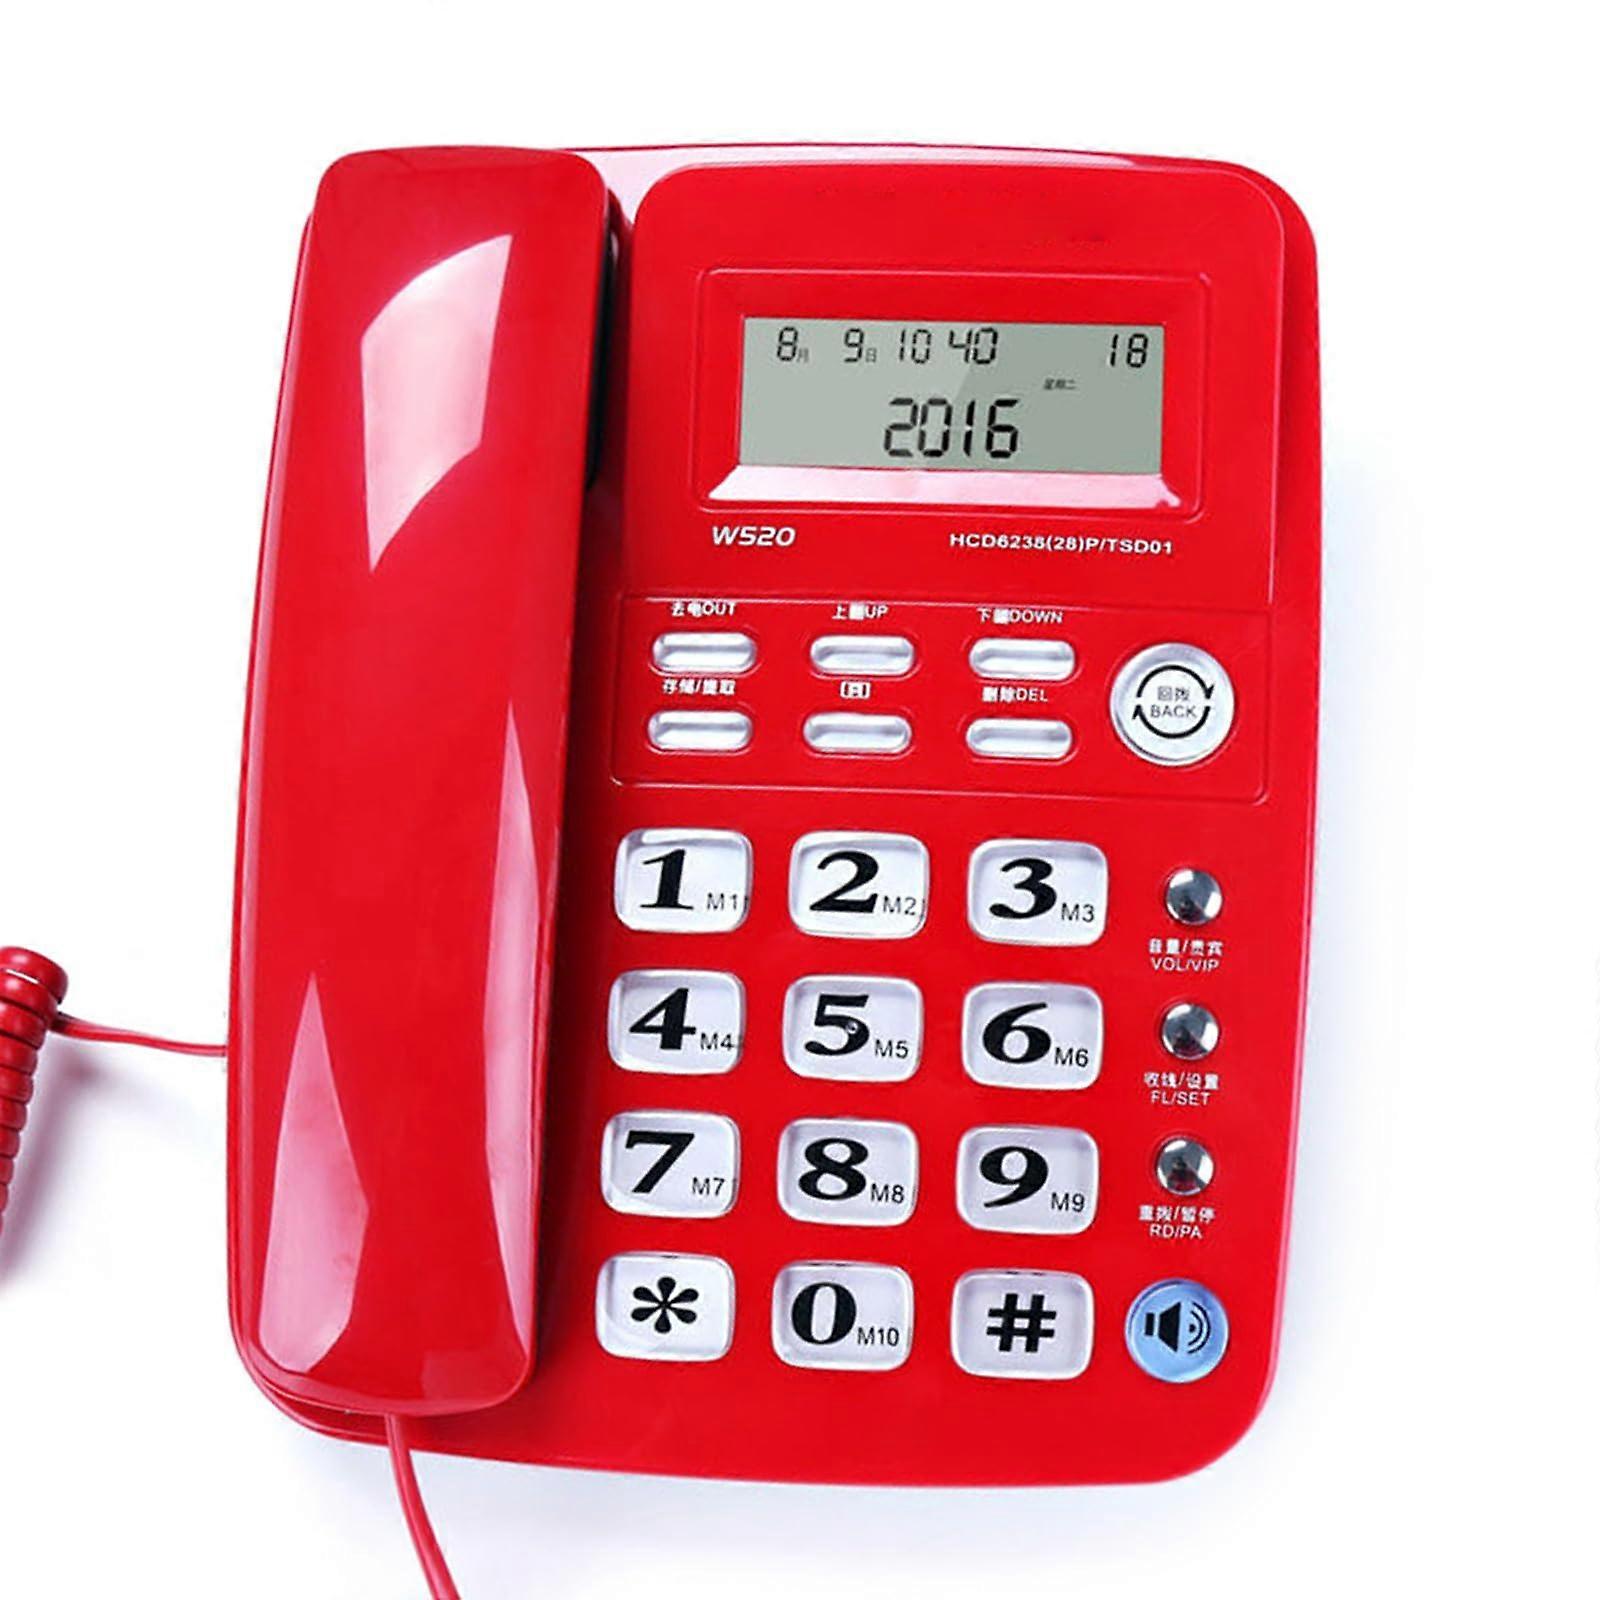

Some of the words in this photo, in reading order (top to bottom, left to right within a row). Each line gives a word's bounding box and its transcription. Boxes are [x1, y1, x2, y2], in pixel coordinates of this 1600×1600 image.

[899, 329, 932, 364] 10
[947, 327, 999, 365] 40
[1107, 333, 1150, 369] 18
[883, 398, 1020, 459] 2016
[711, 526, 797, 547] W520
[949, 532, 1173, 556] HCD6238(28)P/TSD01
[1149, 703, 1198, 720] BACK
[639, 848, 694, 911] 1
[706, 892, 738, 912] M1
[809, 850, 880, 913] 2
[881, 896, 918, 916] M2
[989, 857, 1059, 920] 3
[1060, 902, 1096, 923] M3
[1151, 956, 1220, 972] VOL/VIP
[629, 986, 697, 1051] 4
[699, 1032, 735, 1053] M4
[804, 994, 870, 1057] 5
[873, 1039, 910, 1059] M5
[981, 1002, 1053, 1065] 6
[1054, 1046, 1090, 1069] M6
[1151, 1090, 1211, 1106] FL/SET
[624, 1130, 696, 1194] 7
[691, 1177, 727, 1197] M7
[797, 1137, 870, 1202] 8
[870, 1183, 906, 1205] M8
[979, 1145, 1050, 1209] 9
[1051, 1192, 1086, 1214] M9
[1149, 1223, 1203, 1240] RD/PA
[790, 1281, 858, 1346] 0
[856, 1326, 900, 1348] M10
